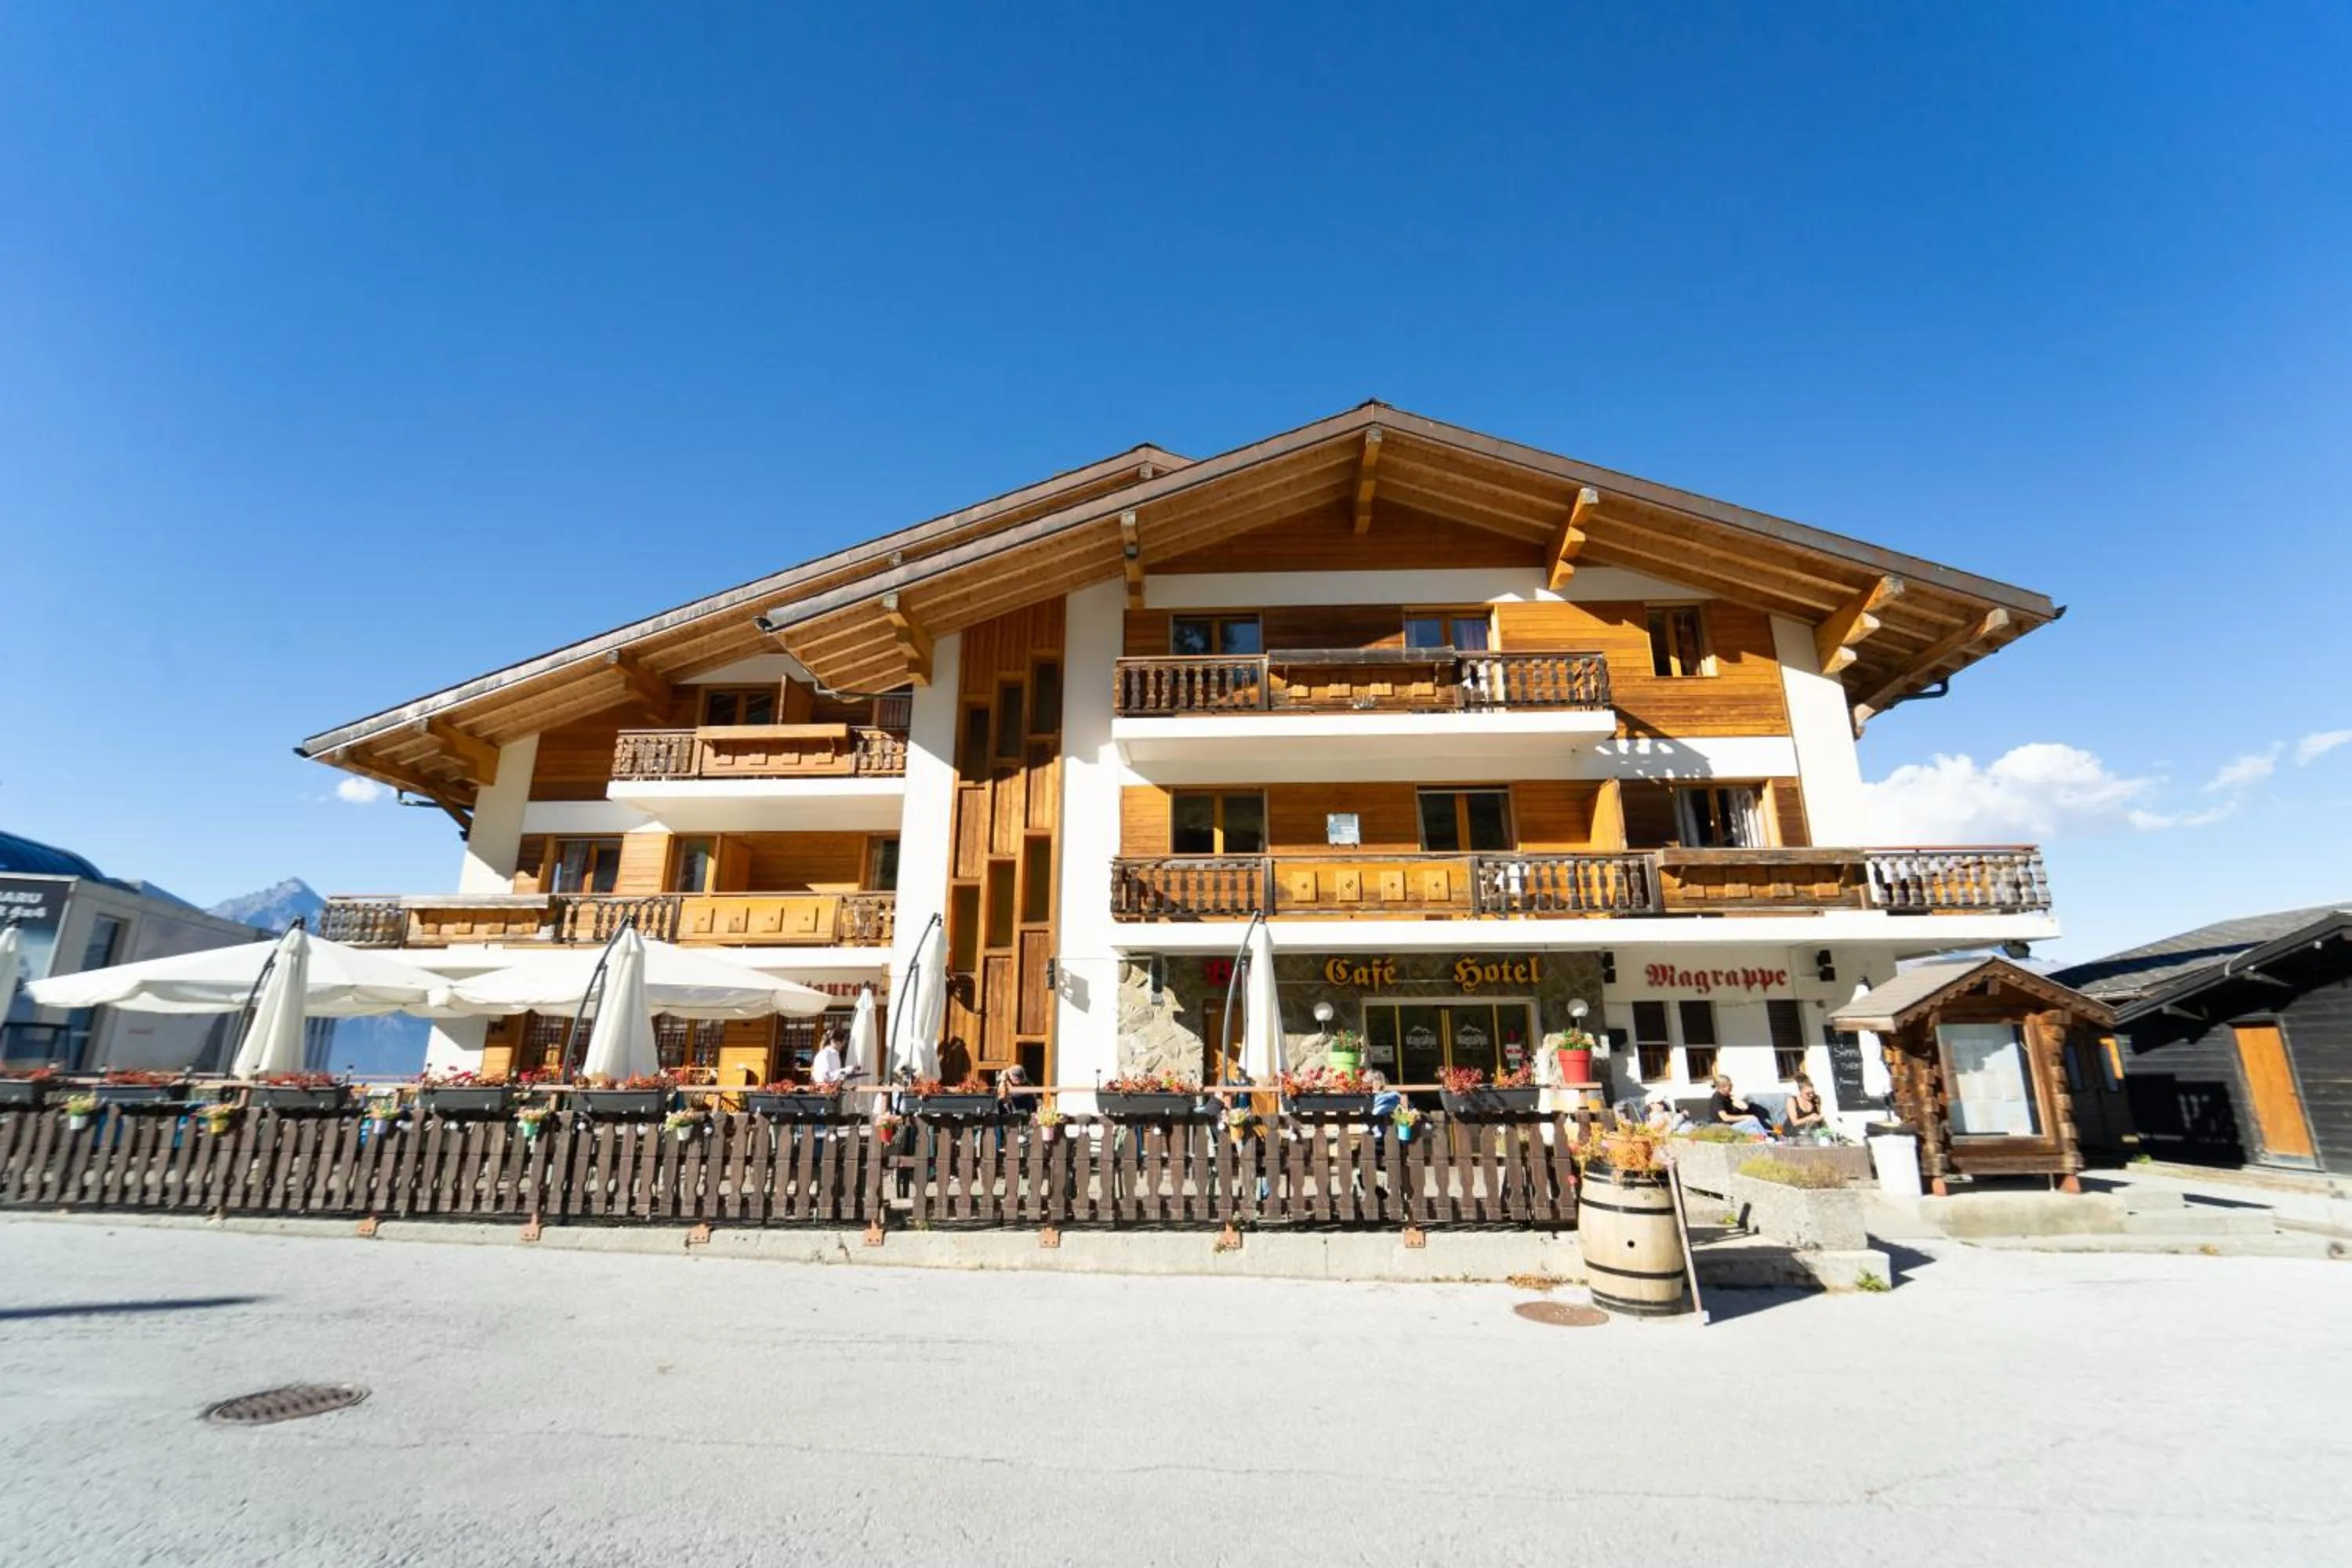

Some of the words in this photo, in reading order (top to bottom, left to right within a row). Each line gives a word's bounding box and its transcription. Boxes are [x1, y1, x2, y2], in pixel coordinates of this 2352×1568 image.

[0, 891, 43, 903] ARU
[1325, 956, 1399, 992] Café
[1454, 955, 1542, 991] Hotel
[1645, 964, 1788, 993] Magrappe
